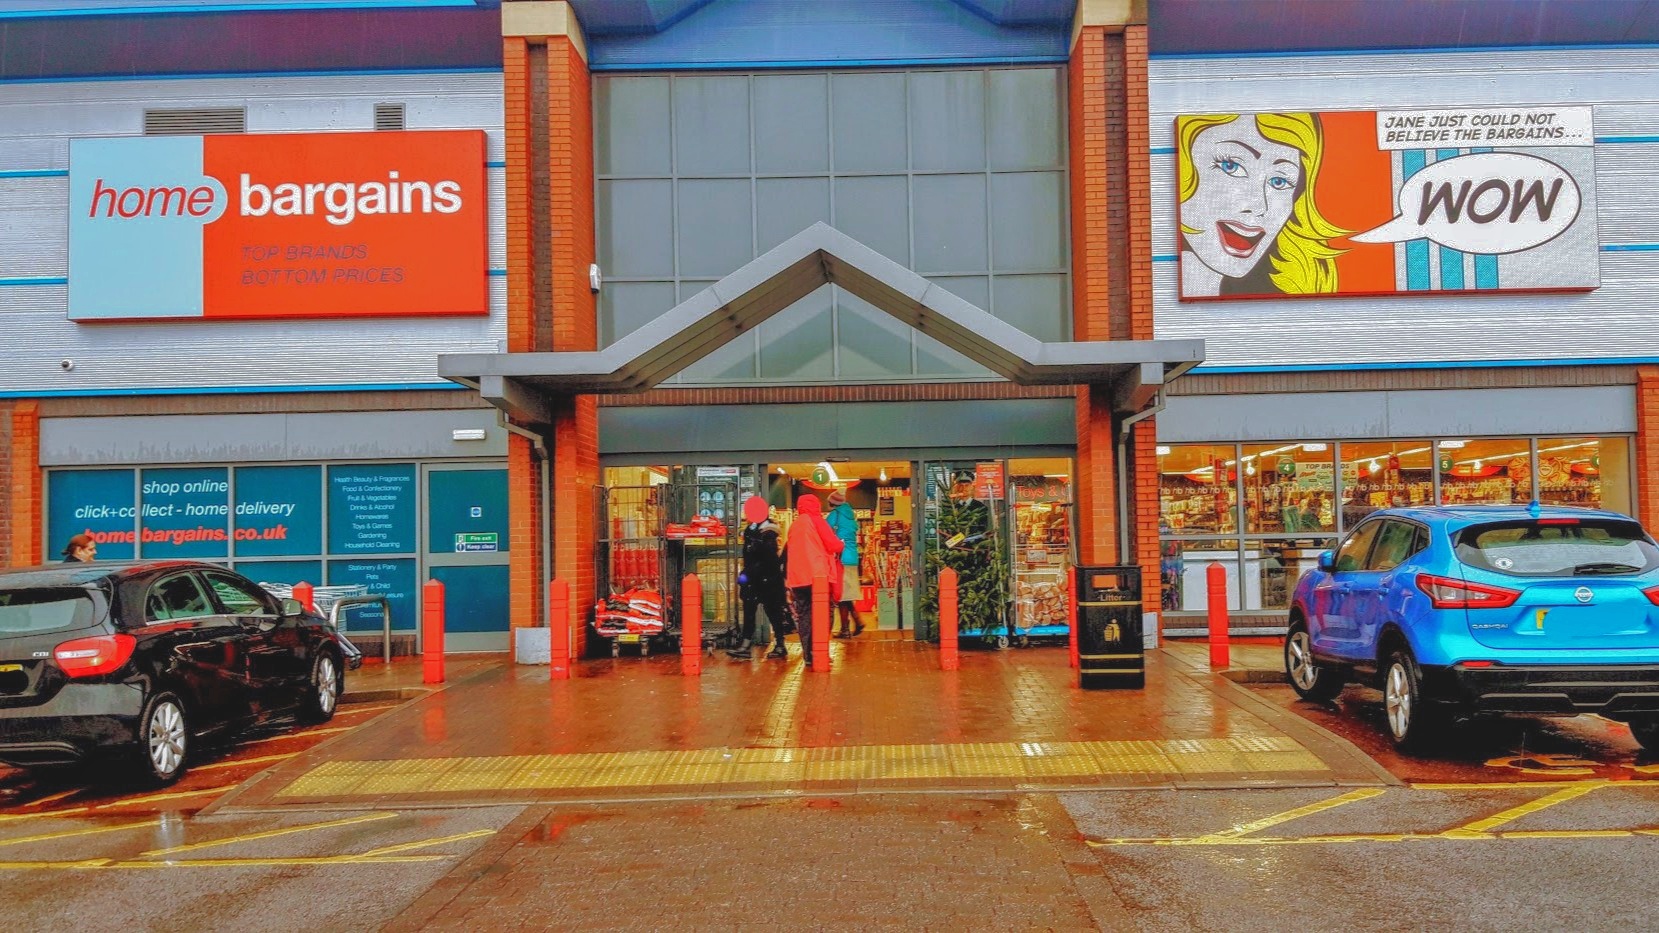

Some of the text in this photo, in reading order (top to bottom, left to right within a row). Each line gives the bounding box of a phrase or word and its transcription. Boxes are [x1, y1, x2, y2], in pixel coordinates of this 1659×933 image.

[1384, 113, 1556, 129] JANE JUST COULD NOT
[1385, 127, 1583, 142] BELIEVE THE BARGAINS...
[88, 171, 463, 226] home bargains
[1416, 177, 1564, 226] WOW
[242, 244, 368, 261] TOP BRANDS
[241, 267, 405, 286] BOTTOM PRICES
[1283, 464, 1290, 472] 4
[1442, 460, 1449, 469] 5
[379, 475, 410, 483] Fragrances
[817, 474, 823, 482] 1
[143, 479, 228, 496] shop online
[1016, 485, 1045, 499] Toys
[1049, 485, 1058, 497] &
[366, 494, 397, 502] Vegetables
[185, 503, 228, 516] home
[235, 502, 295, 517] delivery
[358, 532, 387, 540] Gardening
[382, 563, 397, 571] Party
[1100, 594, 1123, 602] Litter
